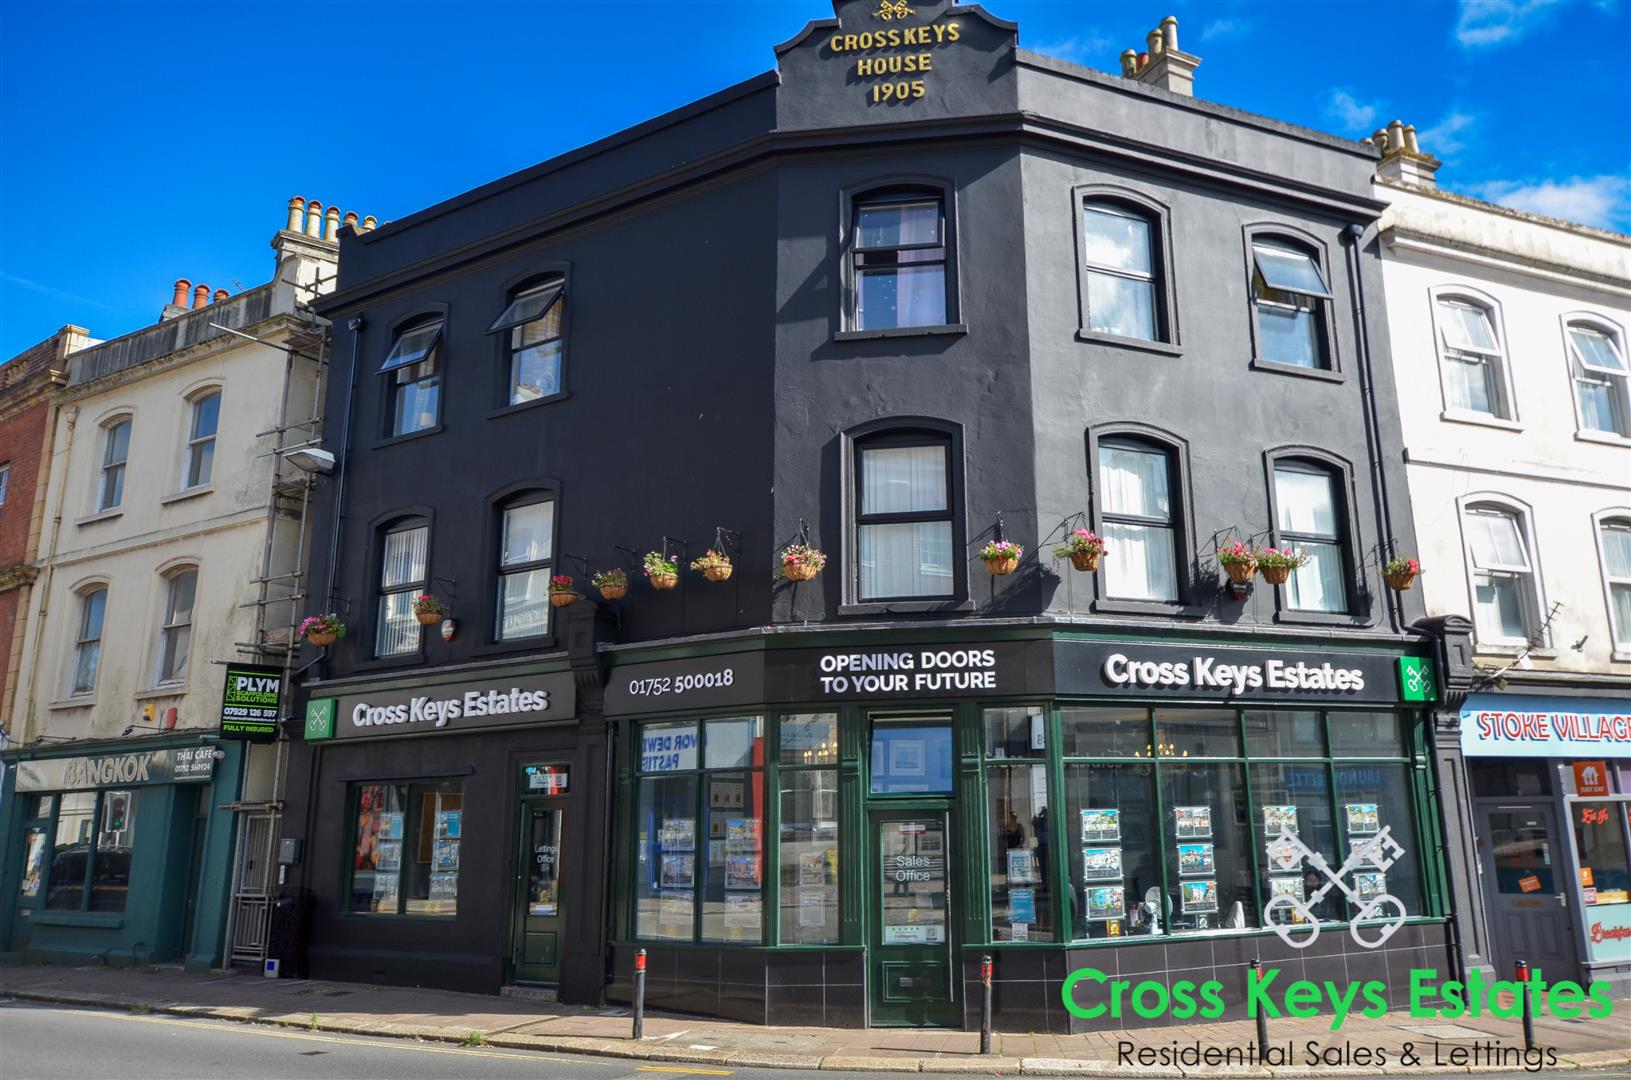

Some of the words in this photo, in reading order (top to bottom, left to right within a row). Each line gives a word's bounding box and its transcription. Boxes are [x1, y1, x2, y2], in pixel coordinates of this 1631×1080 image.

[830, 28, 900, 52] CROSS
[903, 22, 961, 45] KEYS
[856, 53, 932, 76] HOUSE
[872, 80, 925, 102] 1905
[820, 652, 914, 673] OPENING
[920, 649, 996, 669] DOORS
[236, 676, 280, 693] PLYM
[629, 677, 671, 697] 01752
[674, 667, 735, 694] 500018
[820, 675, 848, 694] TO
[850, 673, 909, 693] YOUR
[915, 671, 997, 691] FUTURE
[1103, 653, 1189, 685] Cross
[1192, 656, 1263, 695] Keys
[1265, 659, 1365, 692] Estates
[223, 707, 248, 716] 07929
[235, 696, 277, 704] SOLUTIONS
[352, 703, 409, 727] Cross
[409, 696, 462, 728] Keys
[463, 687, 549, 718] Estates
[245, 725, 274, 733] INSURED
[1477, 712, 1550, 741] STOKE
[177, 751, 193, 761] THAI
[63, 754, 150, 786] BANGKOK
[896, 855, 930, 867] Sales
[895, 869, 930, 882] Office
